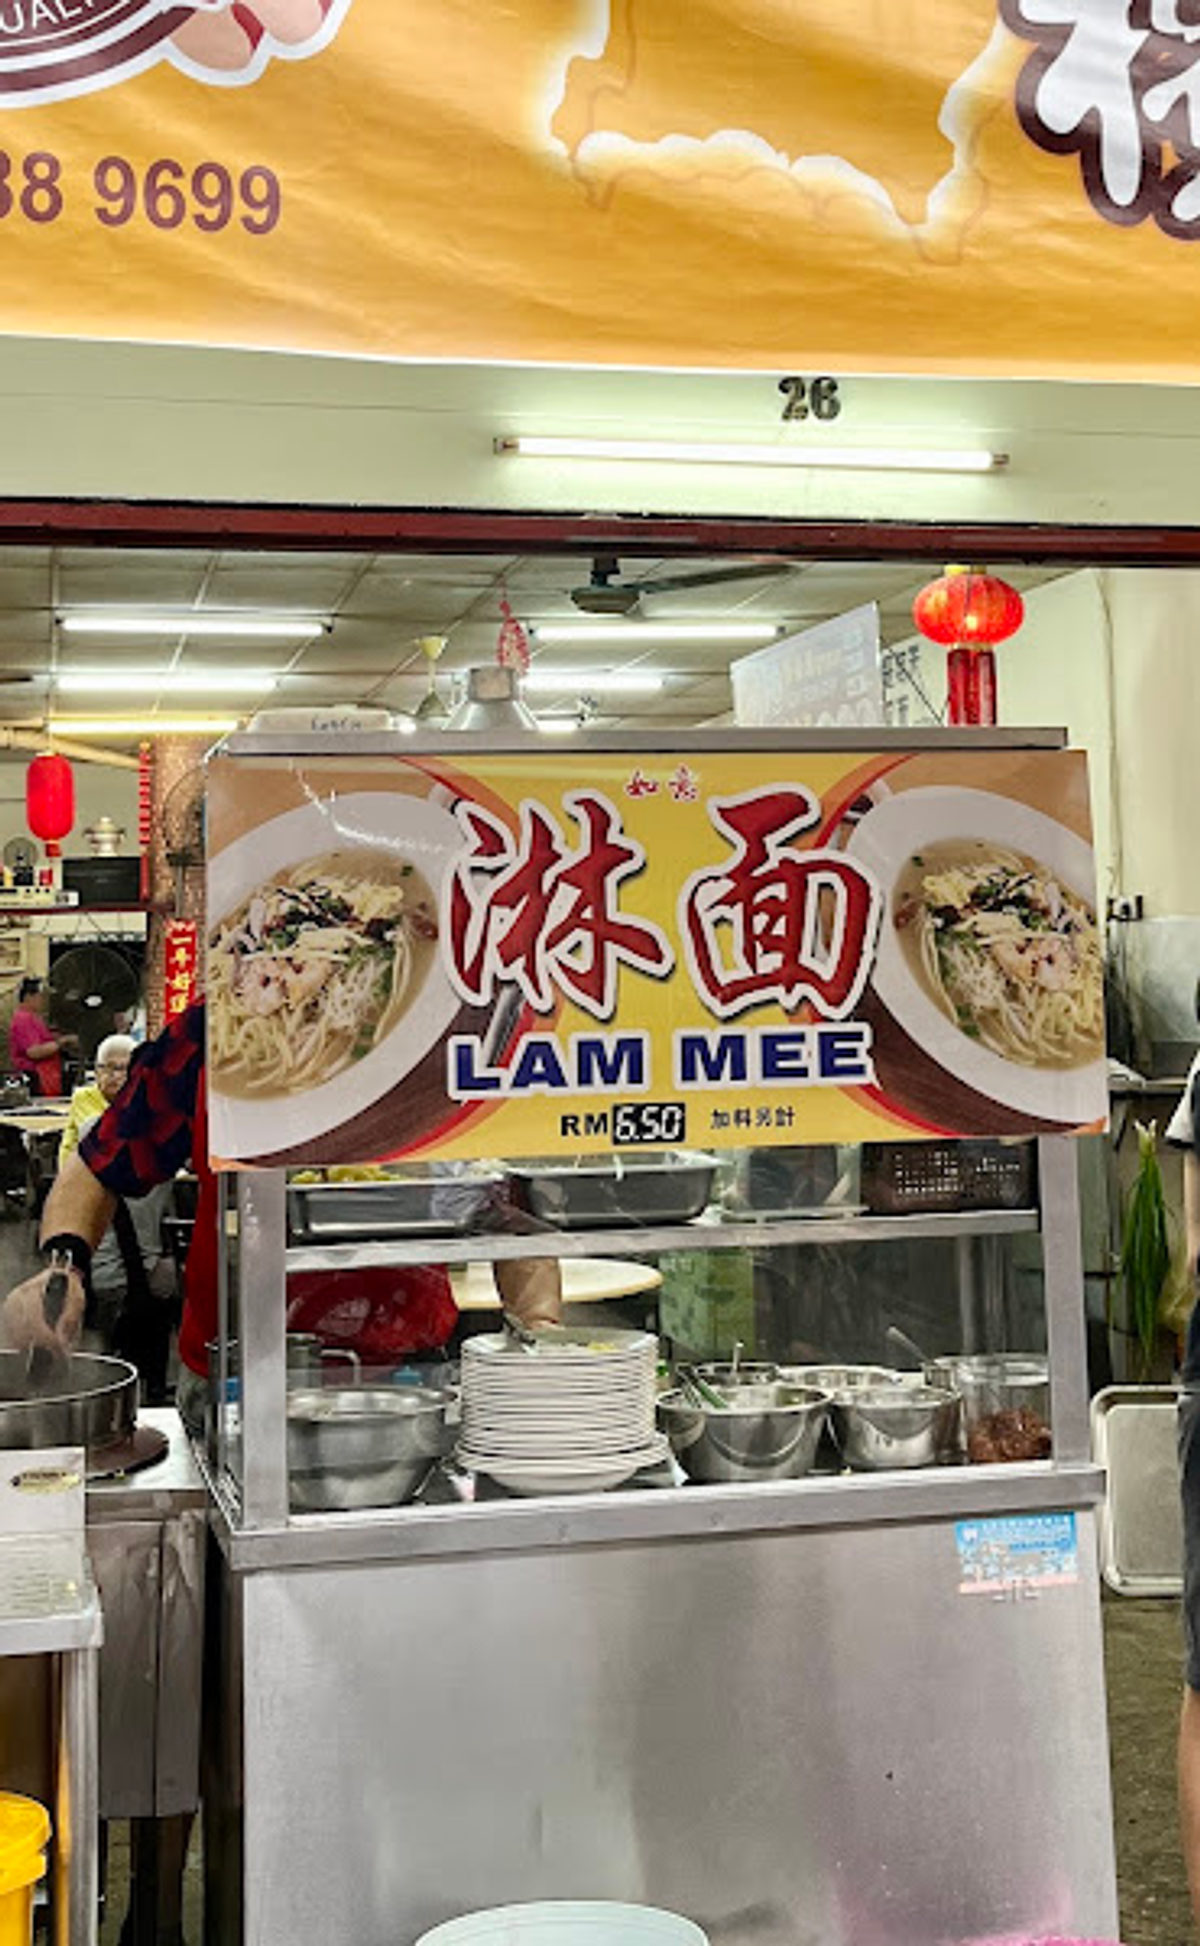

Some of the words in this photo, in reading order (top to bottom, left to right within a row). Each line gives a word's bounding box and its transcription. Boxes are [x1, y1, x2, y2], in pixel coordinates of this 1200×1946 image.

[0, 0, 93, 33] UAL
[0, 149, 63, 223] 8
[94, 156, 281, 235] 9699
[779, 376, 841, 419] 26
[447, 787, 880, 1015] 淋面
[455, 1039, 644, 1090] LAM
[680, 1031, 868, 1081] MEE
[561, 1113, 608, 1136] RM
[615, 1106, 682, 1140] 6.50
